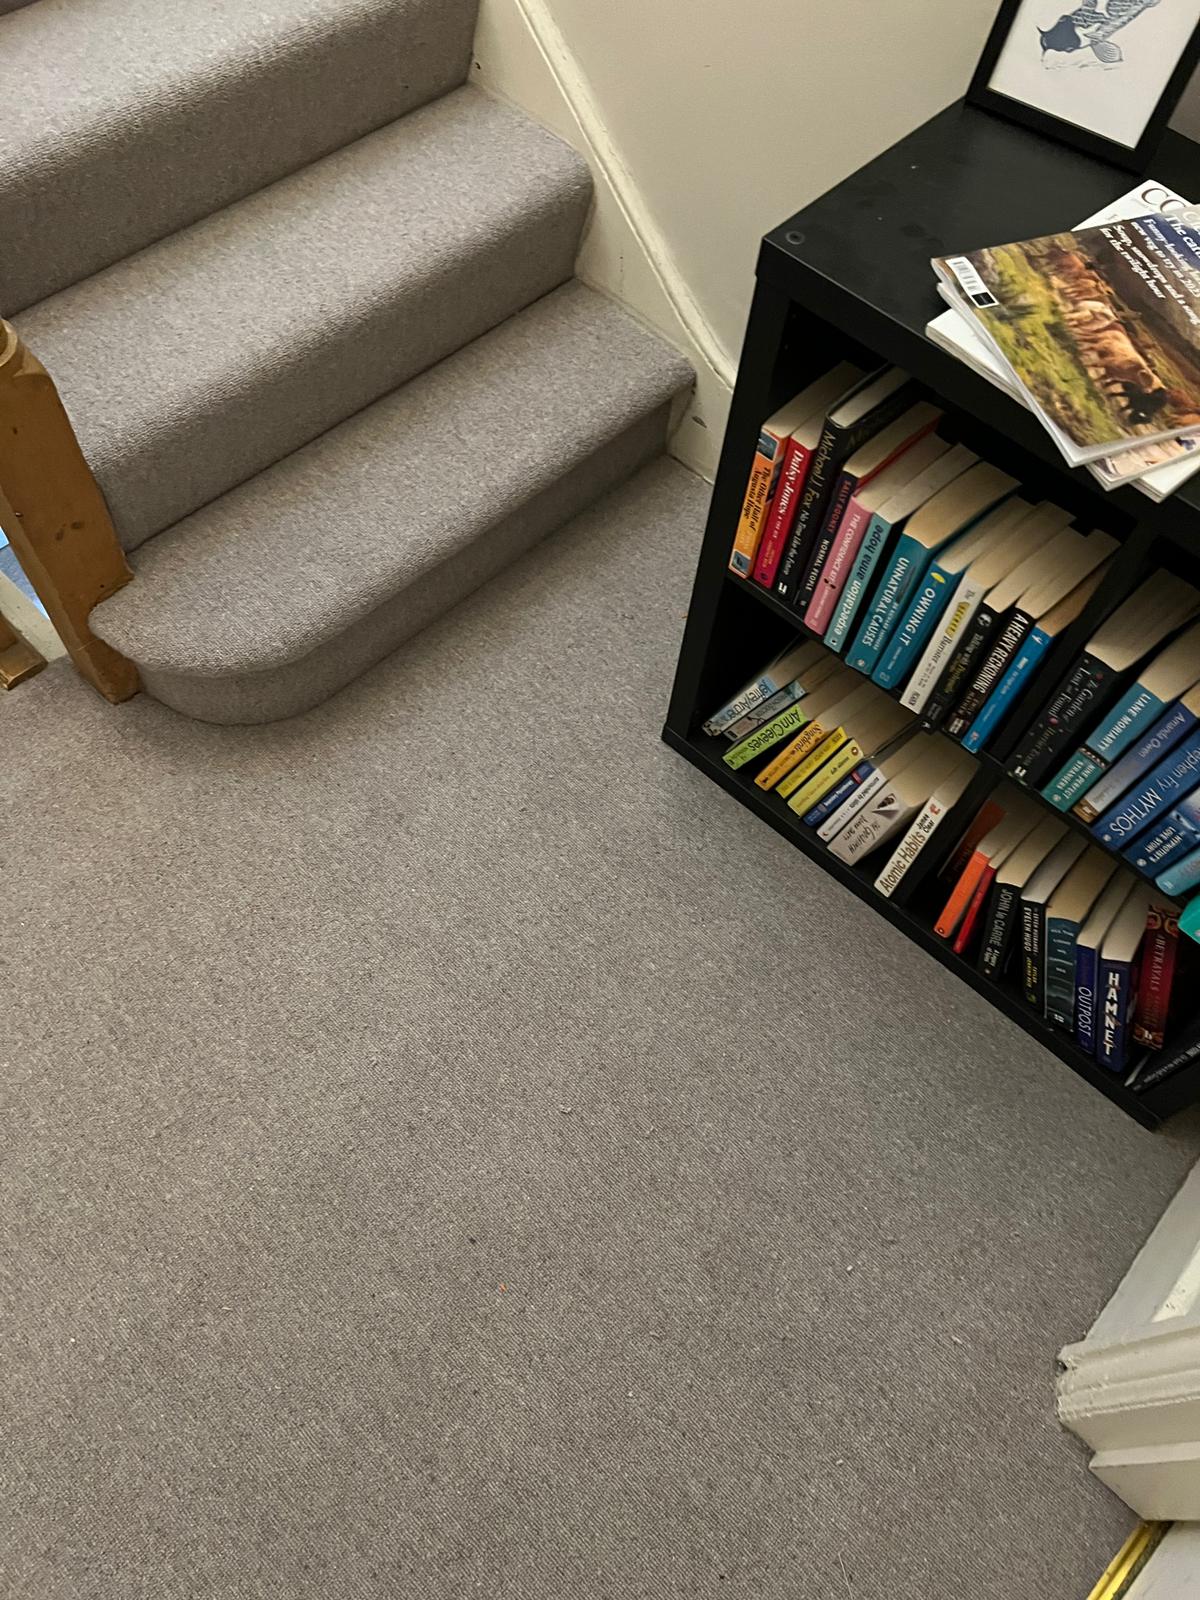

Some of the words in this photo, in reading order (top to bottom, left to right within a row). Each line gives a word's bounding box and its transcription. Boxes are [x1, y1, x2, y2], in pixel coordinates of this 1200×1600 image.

[1130, 222, 1148, 236] new
[1165, 217, 1187, 236] The
[1099, 228, 1114, 239] for
[1109, 240, 1124, 252] the
[1120, 251, 1150, 280] twilight
[1145, 279, 1167, 299] hour
[785, 449, 804, 482] Daisy
[812, 429, 834, 480] Michael
[761, 466, 770, 481] The
[755, 482, 766, 504] Other
[777, 481, 794, 515] Jones
[802, 486, 820, 509] Fox
[837, 479, 851, 504] SALLY
[741, 499, 753, 519] Hope
[750, 504, 761, 522] Half
[799, 509, 809, 523] No
[849, 514, 860, 529] THE
[749, 520, 755, 530] of
[813, 538, 829, 567] NORMAL
[832, 527, 854, 570] CONFIDENCE
[855, 553, 872, 580] anna
[864, 524, 883, 553] hope
[805, 567, 819, 592] PEOPLE
[875, 556, 909, 615] UNNATURAL
[834, 579, 862, 635] expectation
[904, 586, 935, 634] OWNING
[1013, 612, 1029, 625] A
[861, 613, 883, 647] CAUSES
[898, 631, 911, 646] IT
[997, 619, 1025, 652] HEAVY
[930, 635, 951, 663] Barrister
[971, 646, 1008, 694] RECKONING
[1069, 665, 1089, 687] Lost
[1046, 691, 1070, 718] Found
[1065, 688, 1094, 718] Garden
[1126, 692, 1150, 717] LIANE
[779, 709, 800, 729] Ann
[1156, 712, 1185, 741] Amanda
[747, 721, 785, 752] Cleeves
[1096, 714, 1132, 752] MORIARTY
[1136, 735, 1161, 758] Owen
[1055, 759, 1083, 791] STRANGERS
[1080, 762, 1095, 777] NINE
[1171, 747, 1200, 779] ephen
[1061, 774, 1085, 800] PERFECT
[1155, 774, 1180, 791] Fry
[915, 812, 930, 830] James
[1110, 786, 1161, 837] MYTHOS
[1143, 836, 1162, 854] STORY
[1158, 826, 1175, 840] LOVE
[879, 856, 906, 893] Atomic
[897, 830, 926, 864] Habits
[996, 887, 1013, 911] JOHN
[1022, 906, 1032, 931] EVELYN
[1023, 932, 1031, 952] HUGO
[1149, 936, 1165, 991] BETRAYALS
[1076, 985, 1093, 1037] OUTPOST
[1102, 971, 1119, 1055] HAMNET
